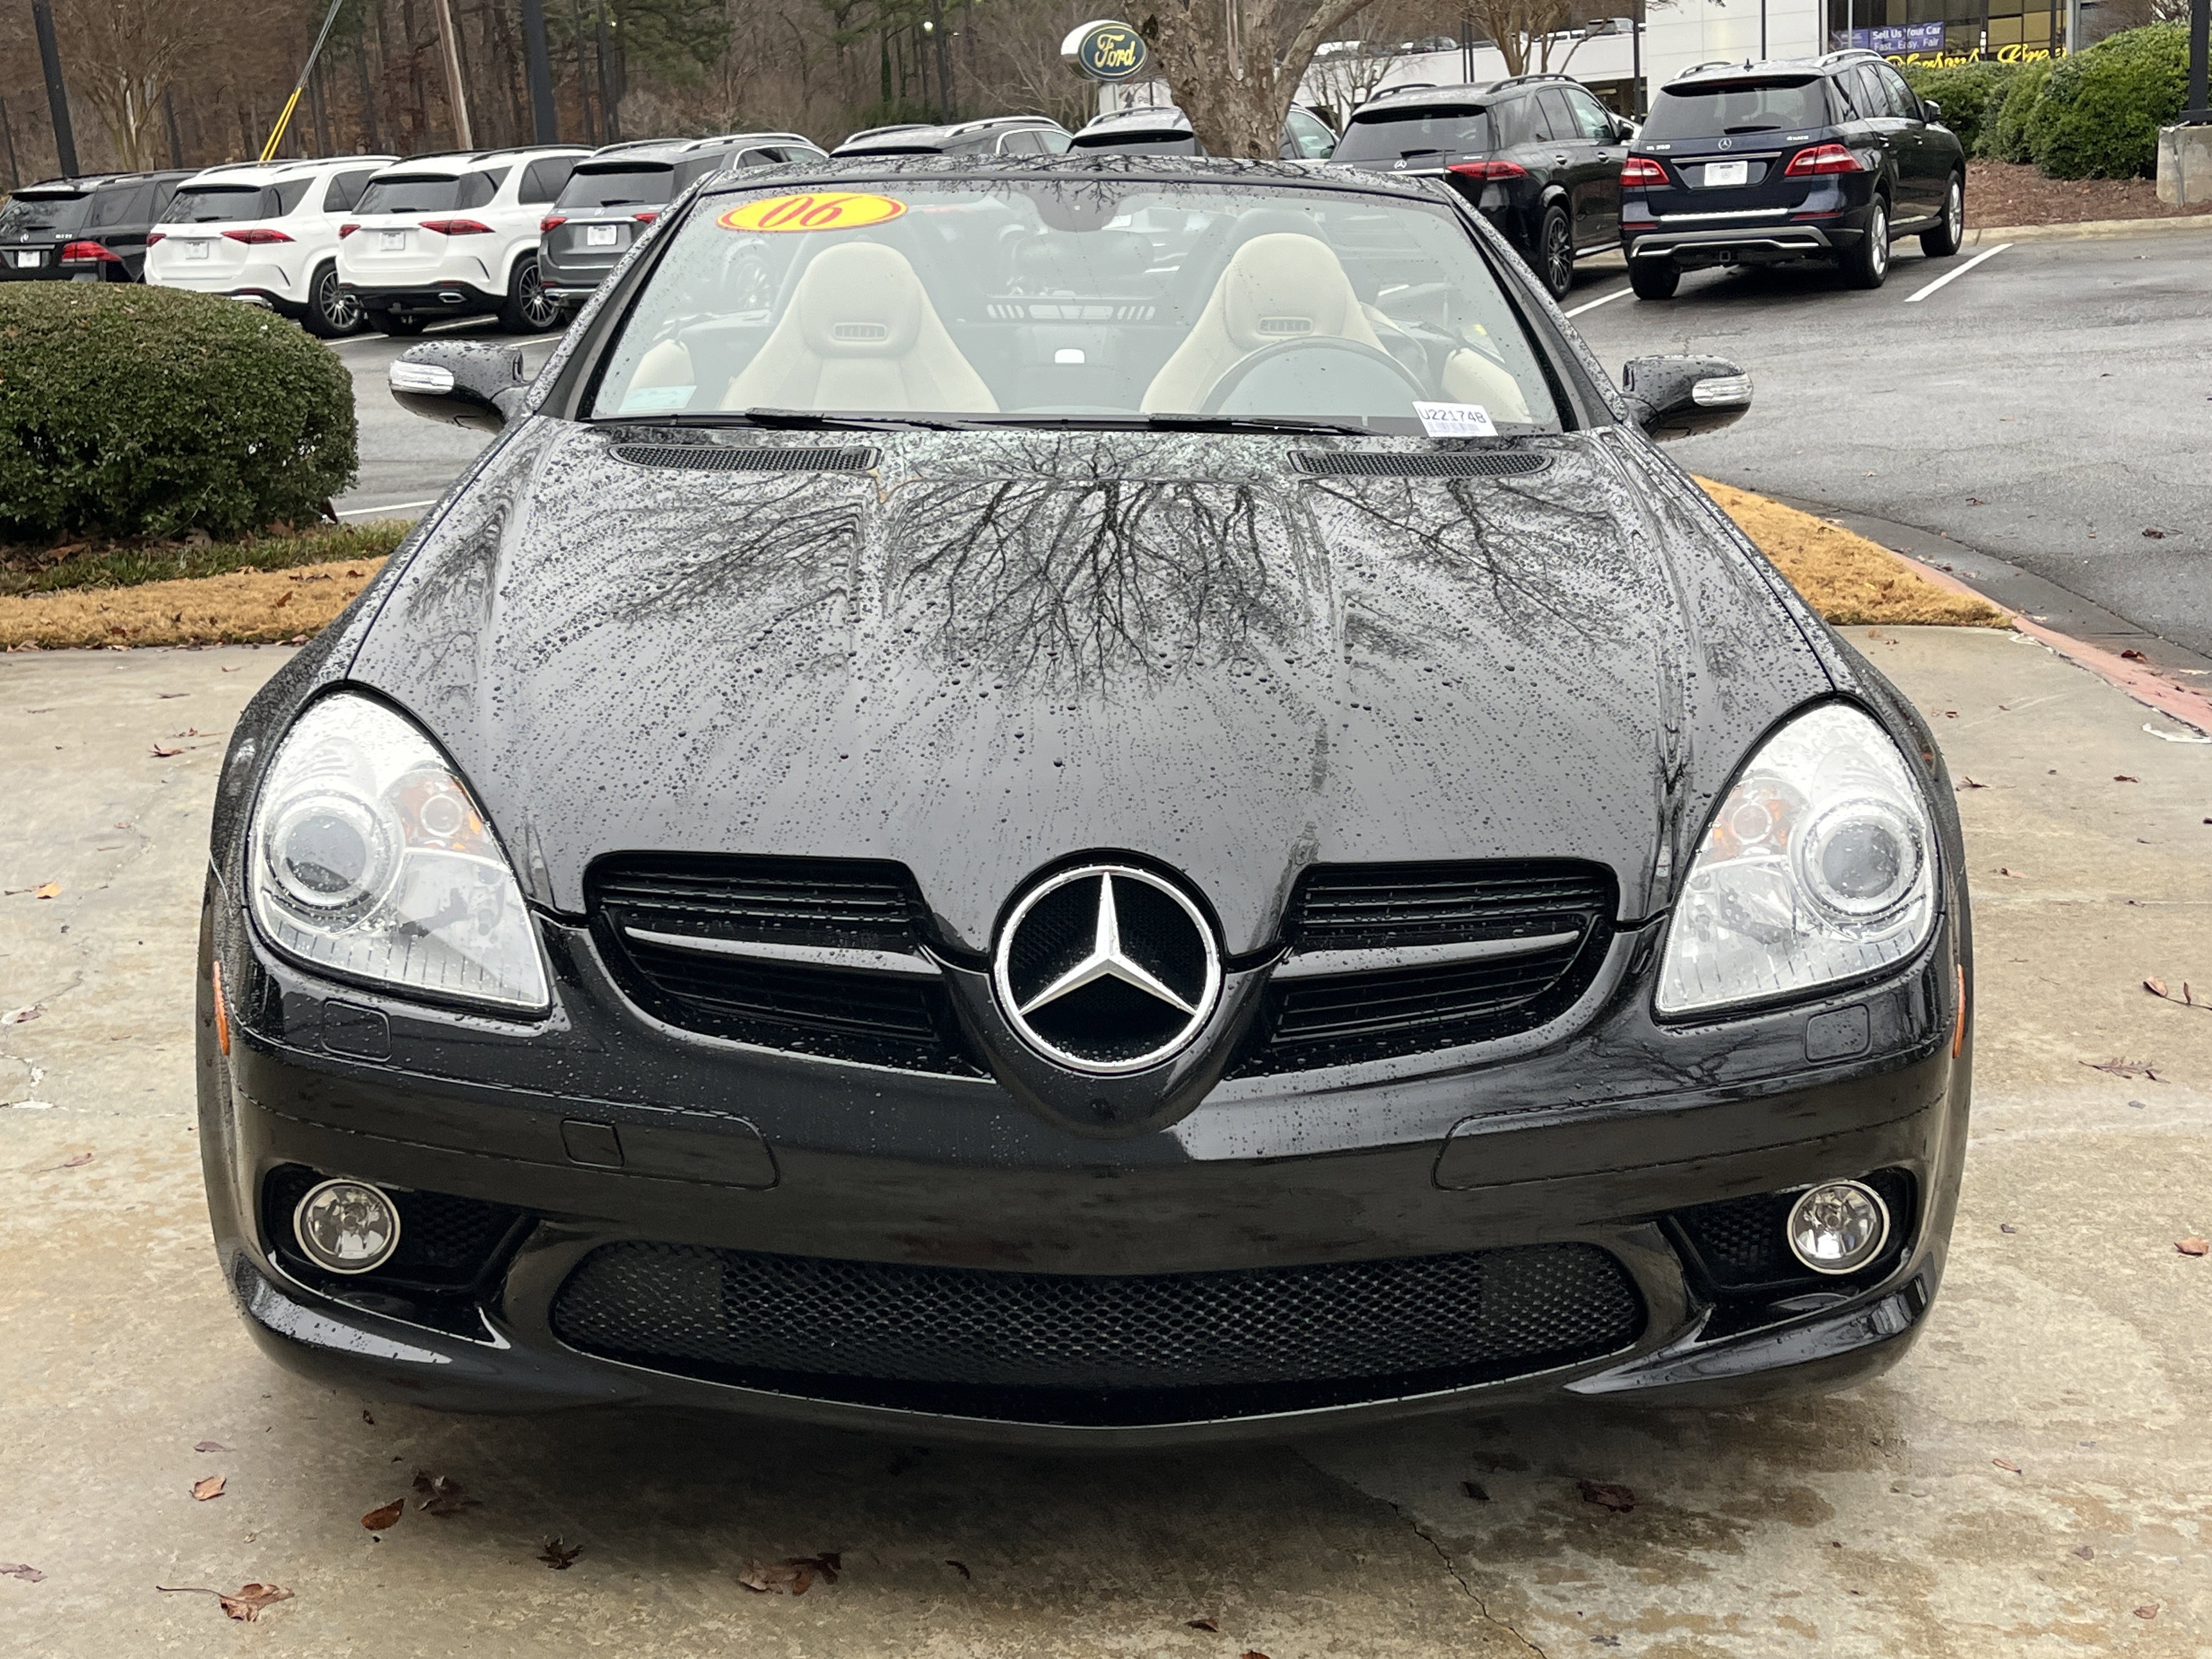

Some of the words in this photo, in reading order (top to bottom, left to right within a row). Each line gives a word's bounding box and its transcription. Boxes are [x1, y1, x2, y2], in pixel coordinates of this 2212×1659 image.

[1872, 30, 1889, 40] Sell
[1891, 29, 1903, 38] Us
[1903, 27, 1925, 37] Your
[1926, 25, 1942, 35] Car
[1094, 33, 1136, 68] Ford
[758, 196, 864, 228] 06
[1418, 408, 1487, 424] U22174B
